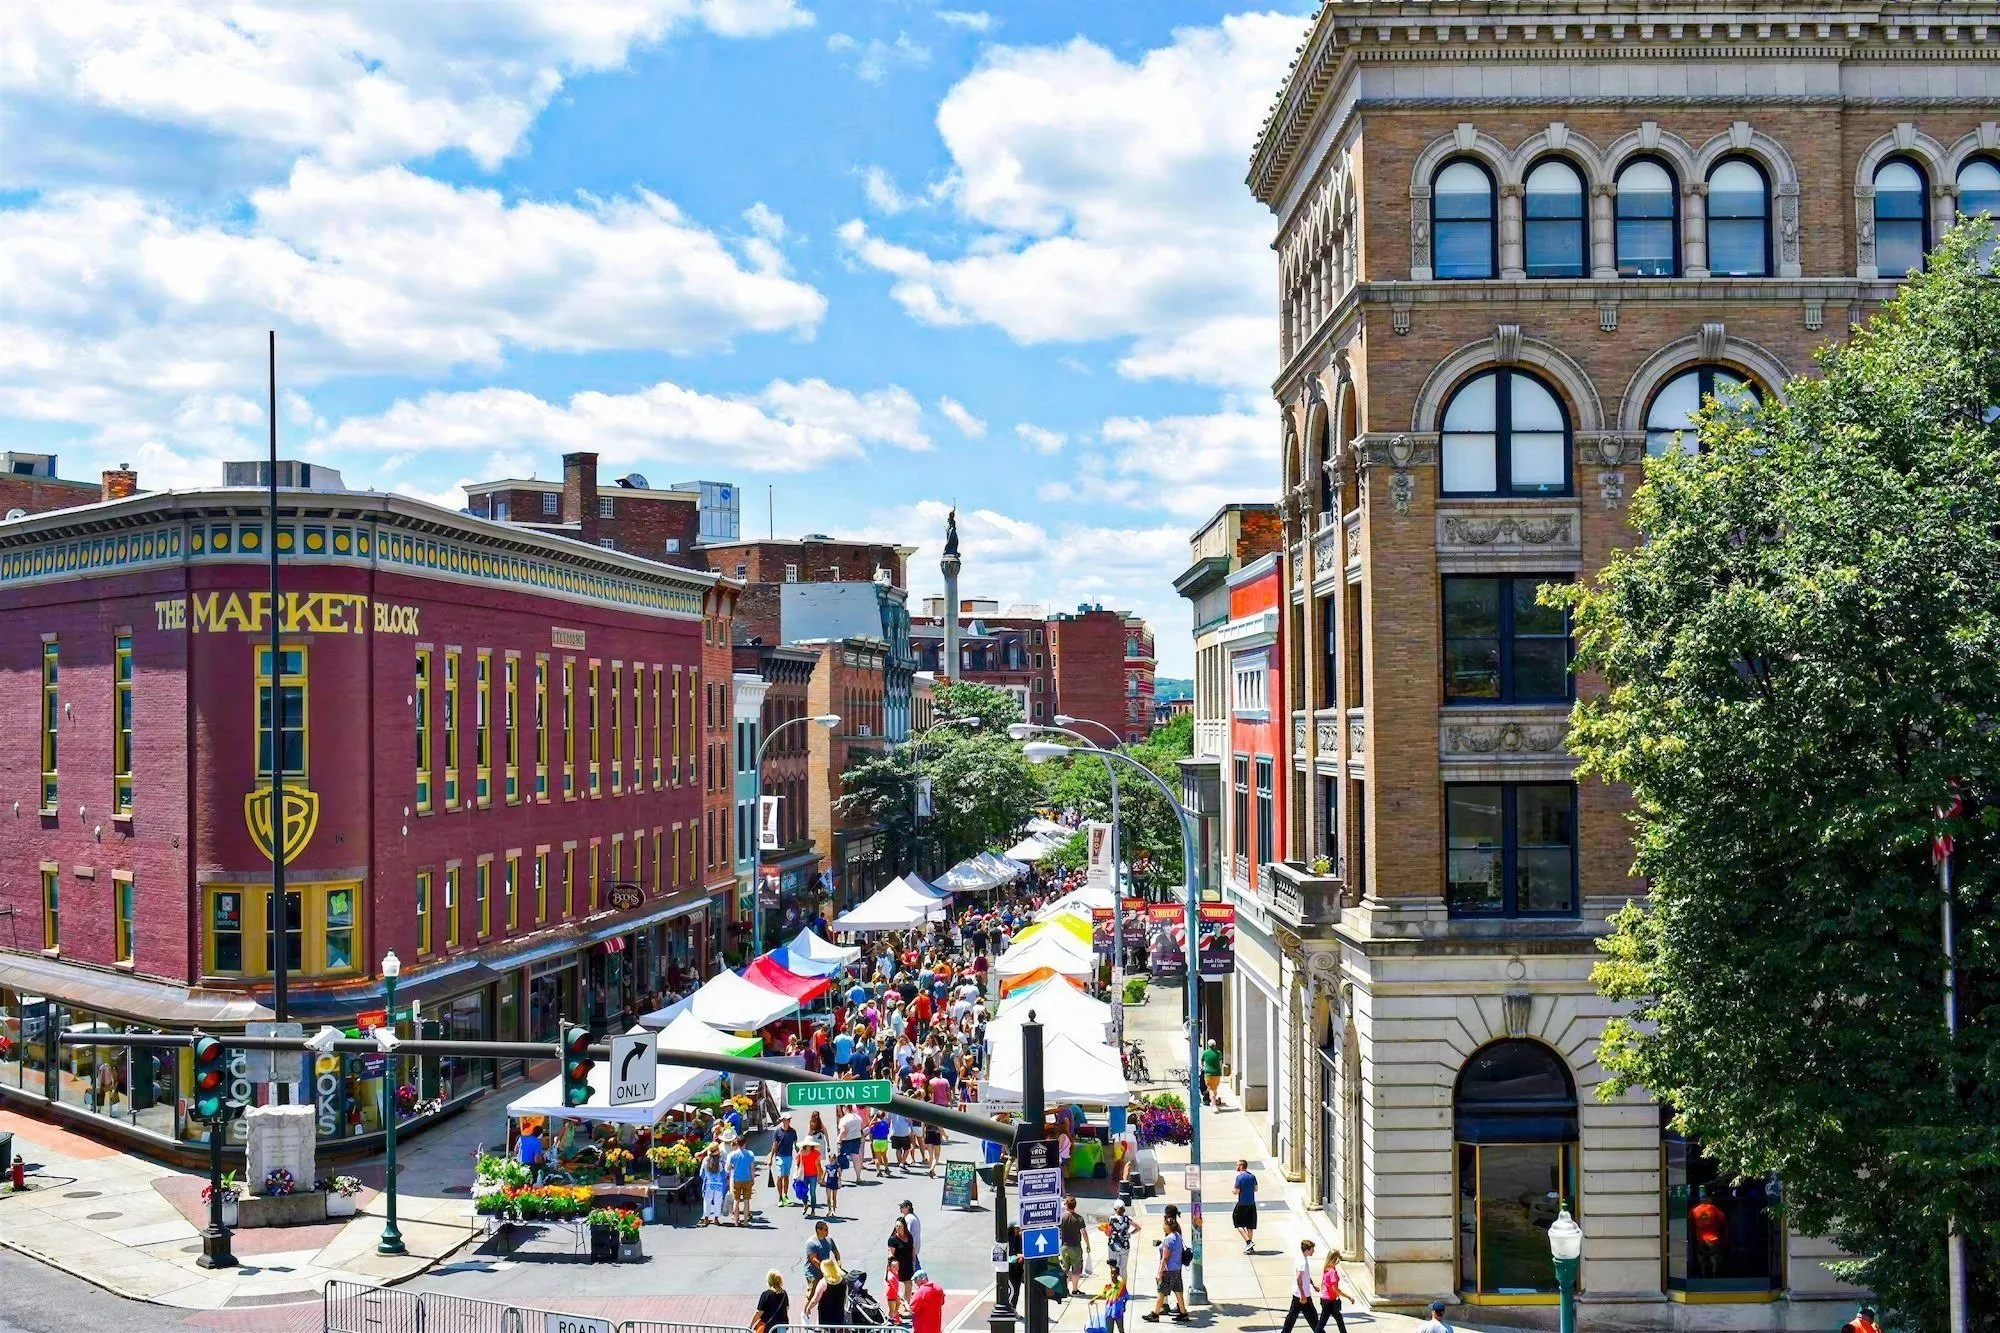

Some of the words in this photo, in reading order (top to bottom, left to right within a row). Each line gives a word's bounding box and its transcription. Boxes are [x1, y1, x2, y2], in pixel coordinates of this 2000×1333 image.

[155, 599, 187, 630] THE
[192, 591, 368, 634] MARKET
[374, 602, 419, 636] BLOCK
[316, 1053, 336, 1135] OOKS
[617, 1083, 649, 1099] ONLY
[798, 1086, 855, 1101] FULTON
[861, 1085, 880, 1099] ST
[1025, 1203, 1038, 1211] HART
[559, 1321, 597, 1333] ROAD
